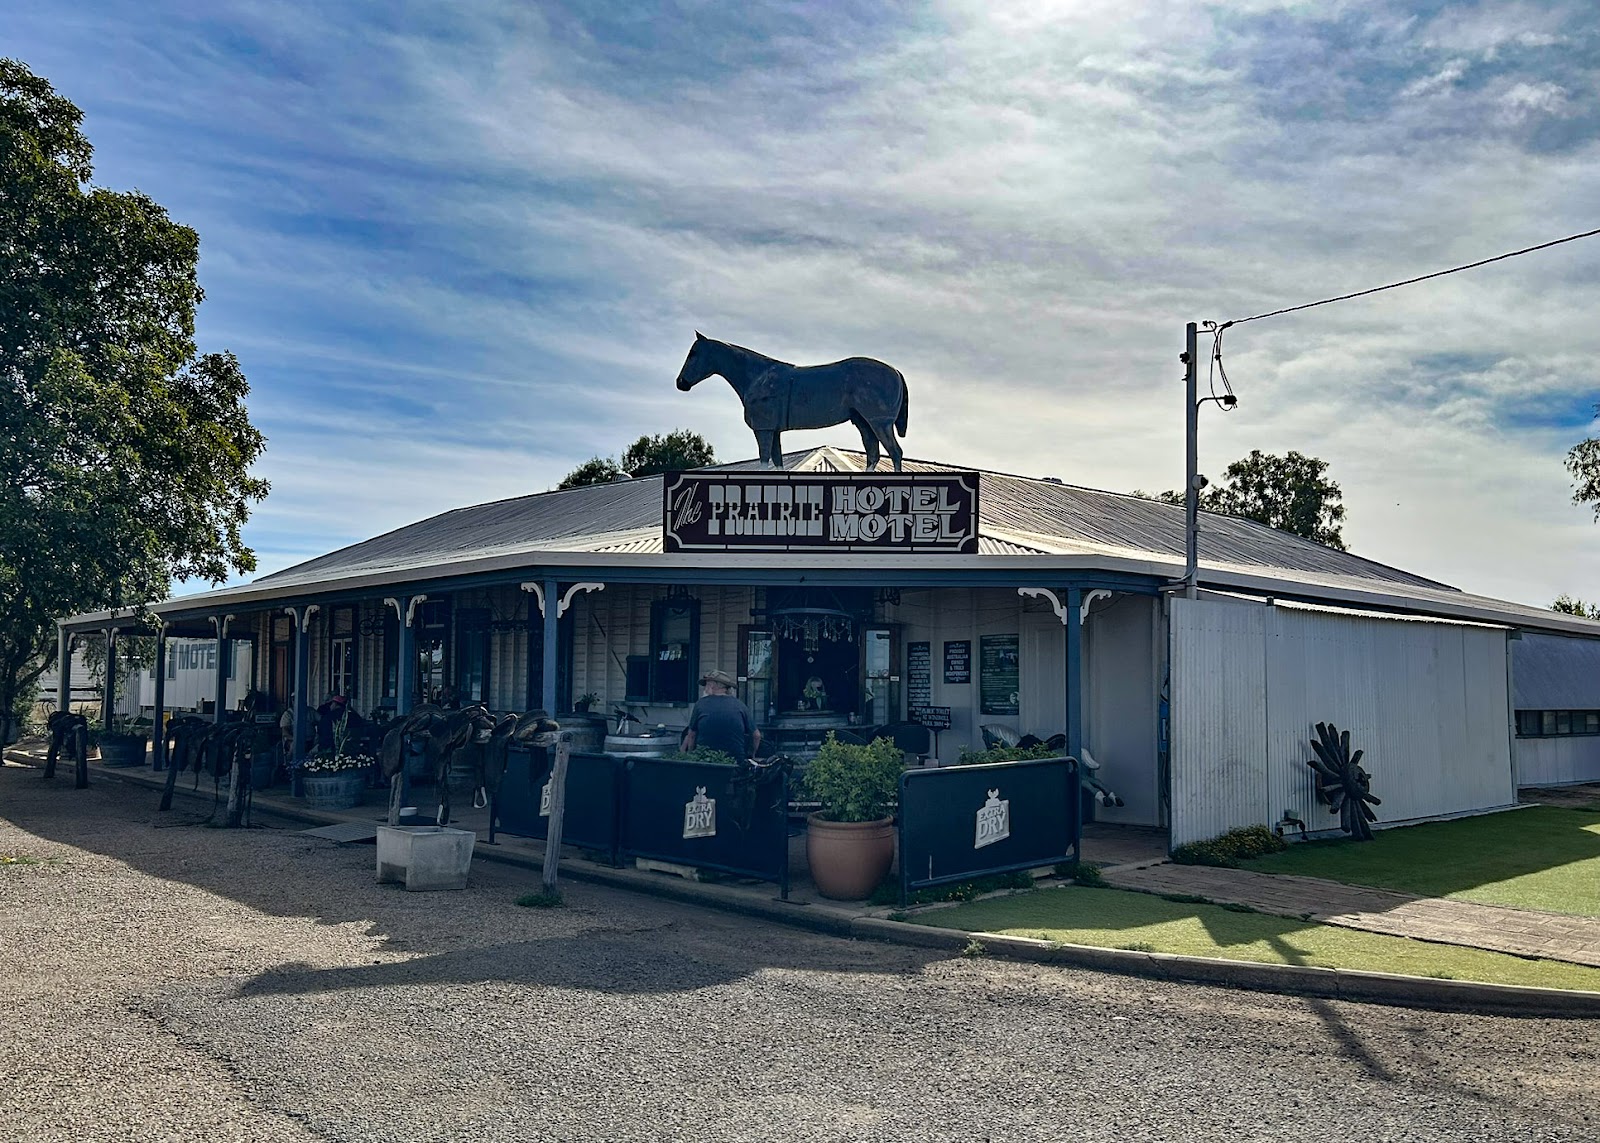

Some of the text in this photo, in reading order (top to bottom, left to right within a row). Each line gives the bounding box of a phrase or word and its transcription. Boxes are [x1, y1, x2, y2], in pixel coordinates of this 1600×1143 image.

[674, 481, 960, 536] The PRAIRIE HOTEL
[829, 513, 965, 542] MOTEL
[178, 643, 217, 670] MOTE
[686, 810, 713, 831] DRY
[687, 802, 713, 814] EXTRA
[979, 804, 1006, 821] EXTRA
[979, 812, 1006, 840] DRY
